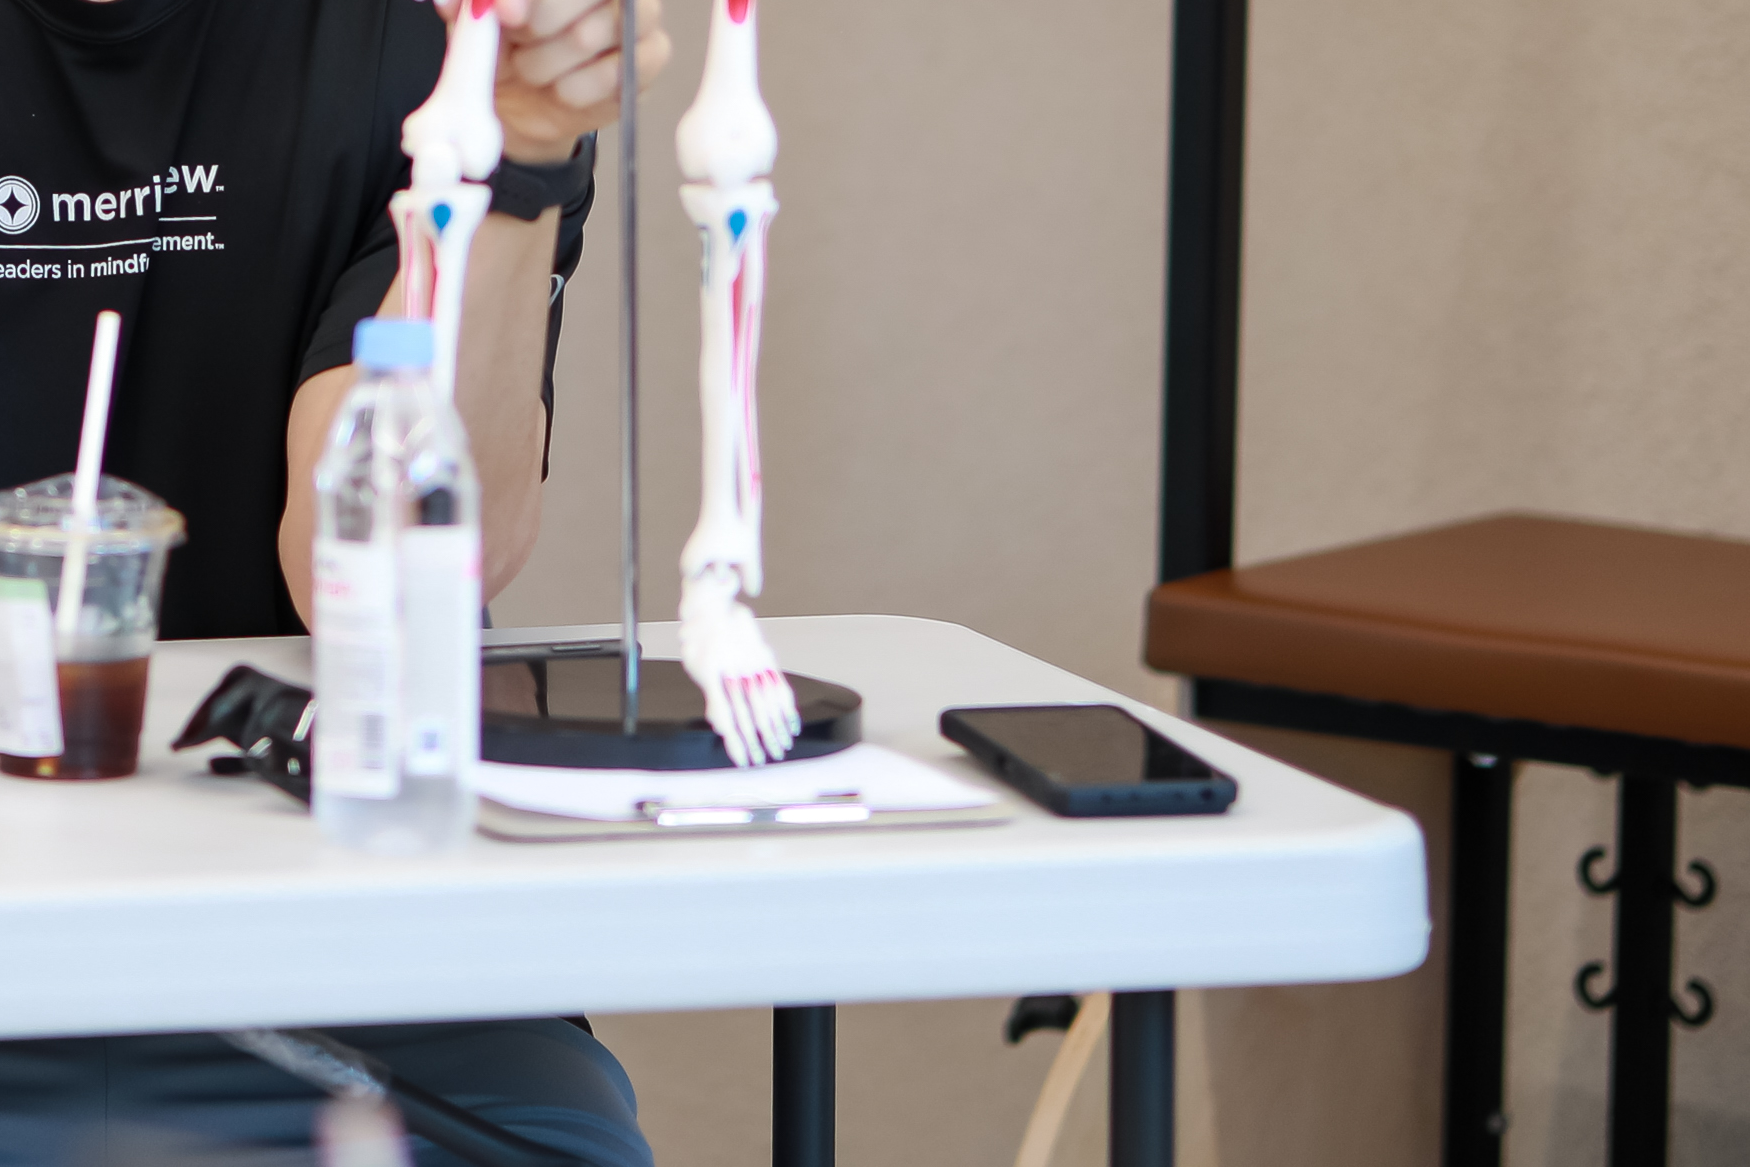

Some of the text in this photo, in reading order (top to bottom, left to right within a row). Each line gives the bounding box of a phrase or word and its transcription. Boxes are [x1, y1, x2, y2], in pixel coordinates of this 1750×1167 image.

[52, 164, 219, 221] merriew
[68, 260, 85, 278] in
[90, 254, 150, 278] mindf
[152, 232, 215, 251] ement
